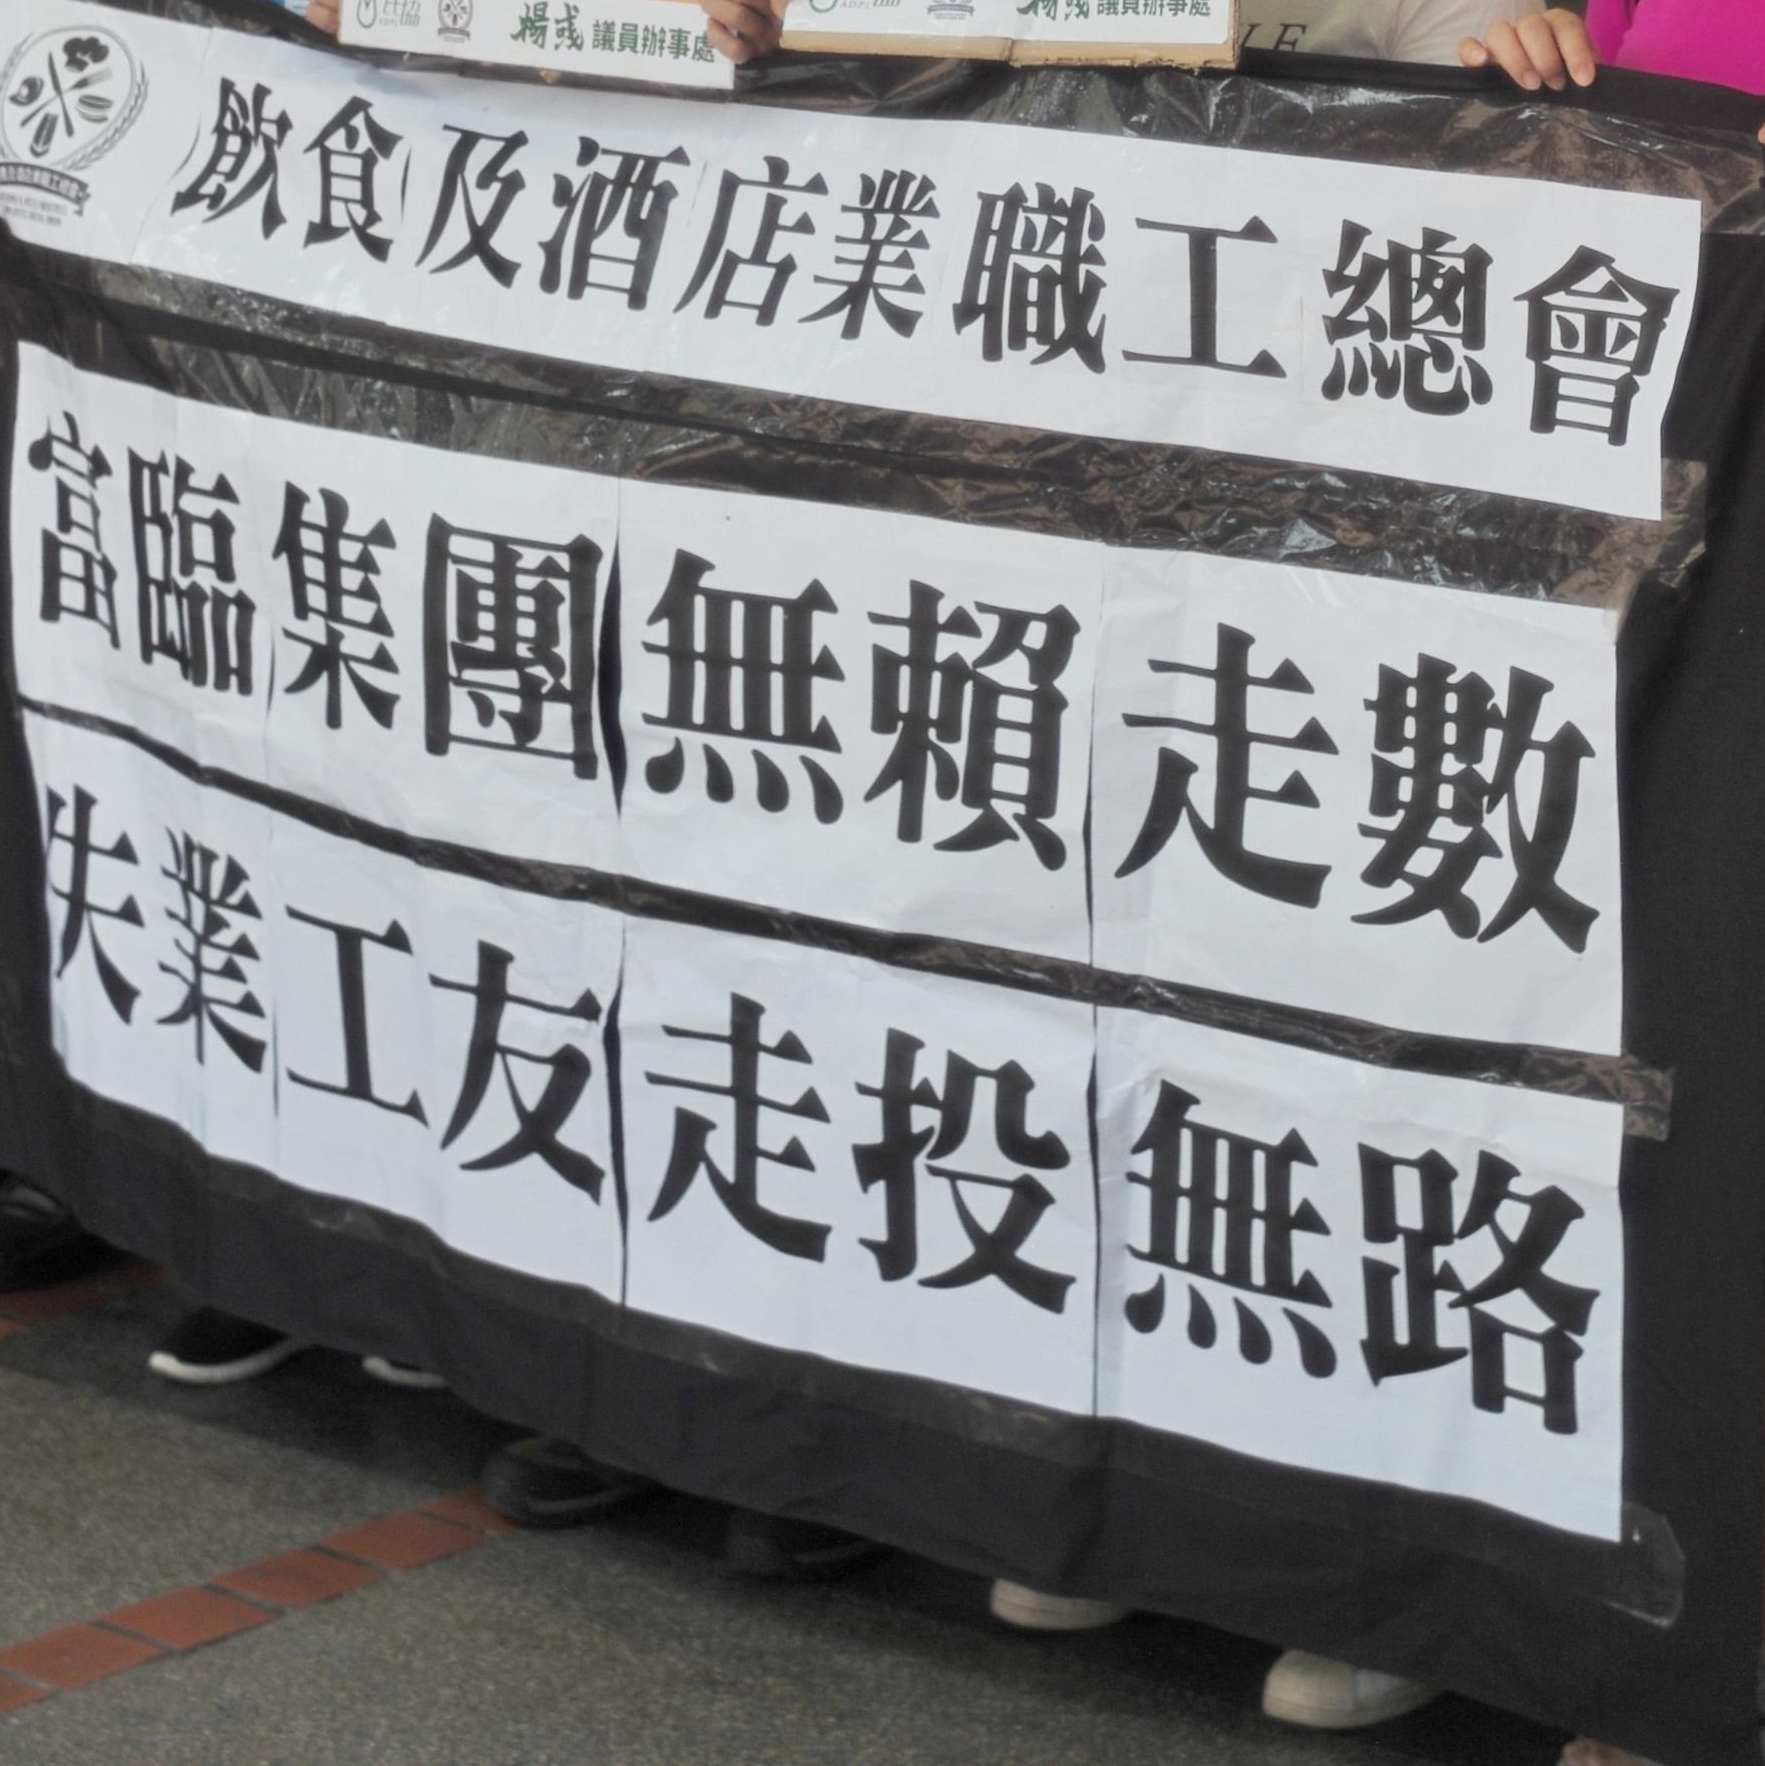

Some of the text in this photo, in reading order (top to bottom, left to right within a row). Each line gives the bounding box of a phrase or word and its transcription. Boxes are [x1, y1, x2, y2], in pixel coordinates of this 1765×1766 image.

[171, 76, 1681, 447] 飲食及酒店業職工總會
[591, 19, 716, 64] 議員辦事處
[28, 410, 1599, 954] 富臨集團無賴走數
[46, 782, 1599, 1435] 失業工友走投無路
